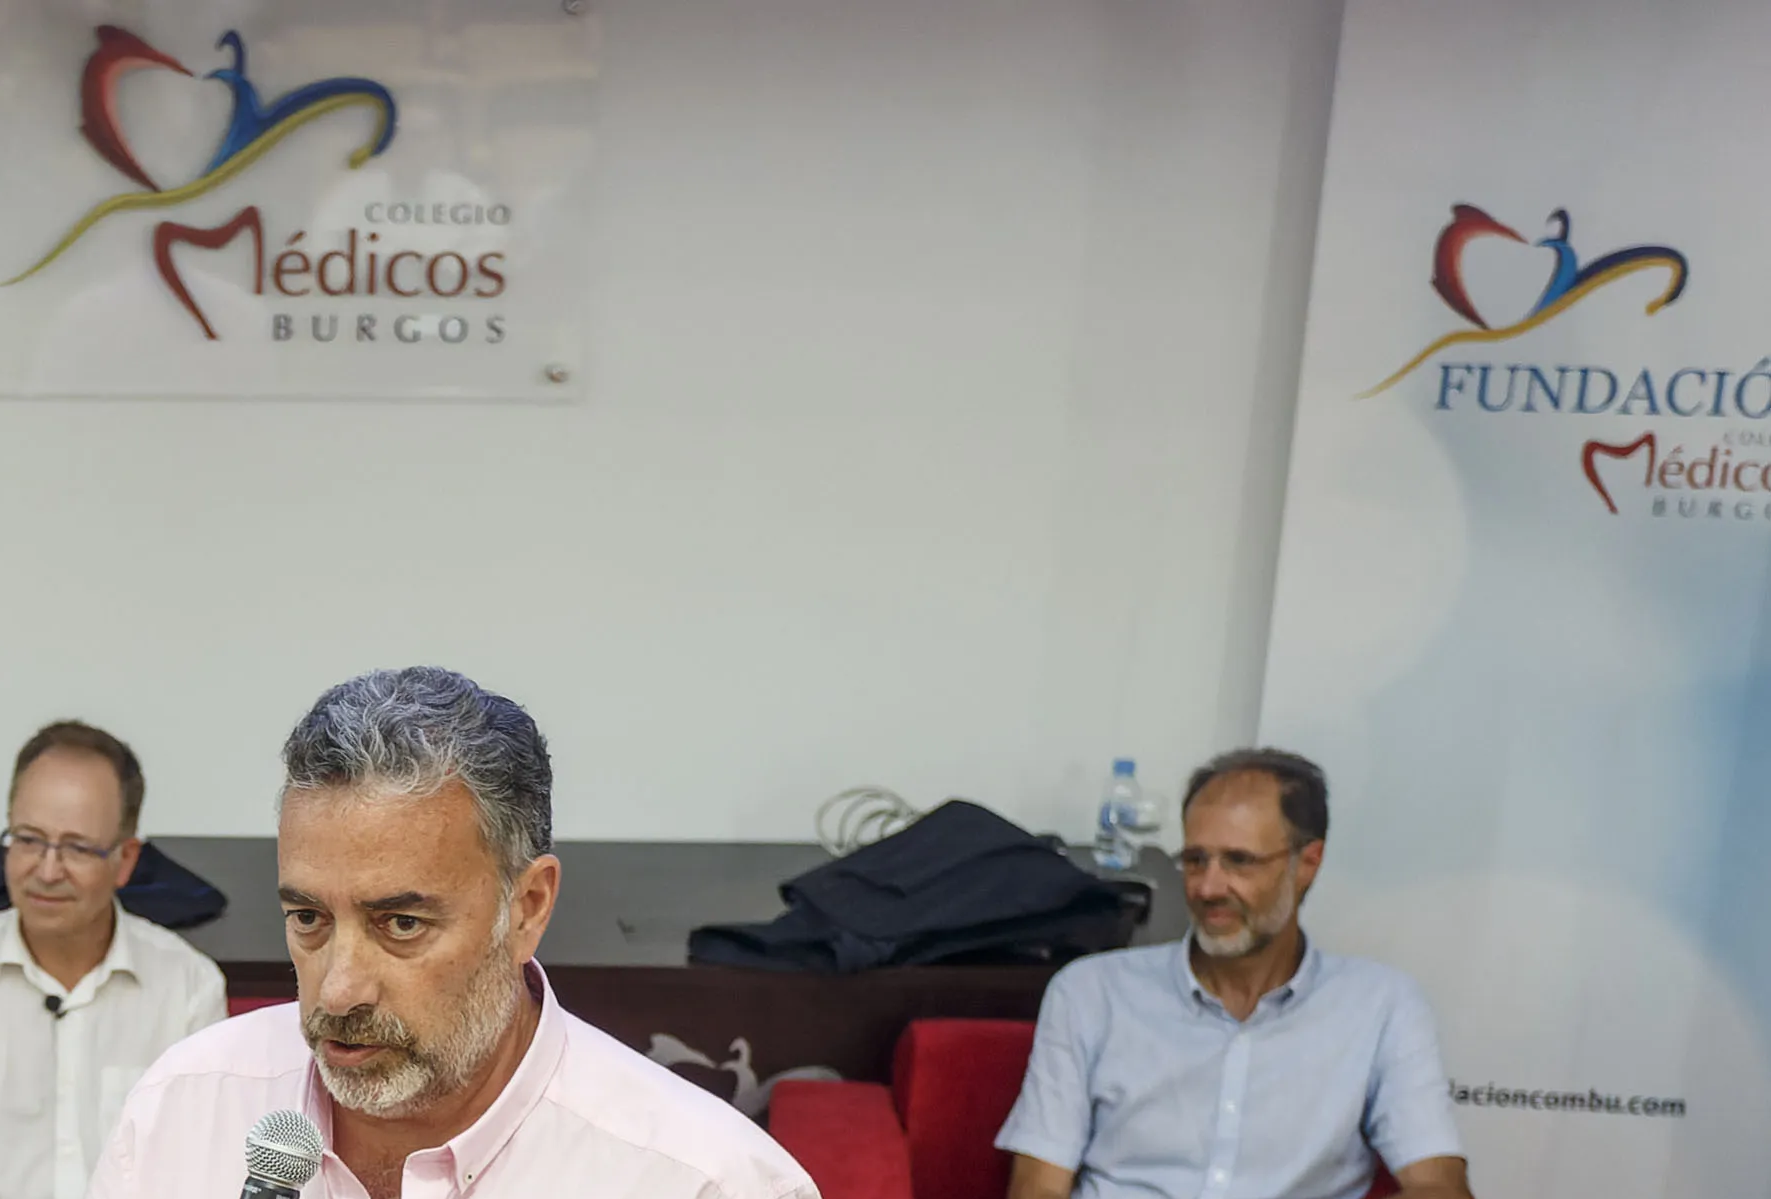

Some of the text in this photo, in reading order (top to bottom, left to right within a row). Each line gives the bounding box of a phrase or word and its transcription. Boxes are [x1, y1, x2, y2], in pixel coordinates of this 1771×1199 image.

[363, 202, 512, 226] COLEGIO
[153, 205, 507, 341] Médicos
[271, 314, 506, 344] BURGOS
